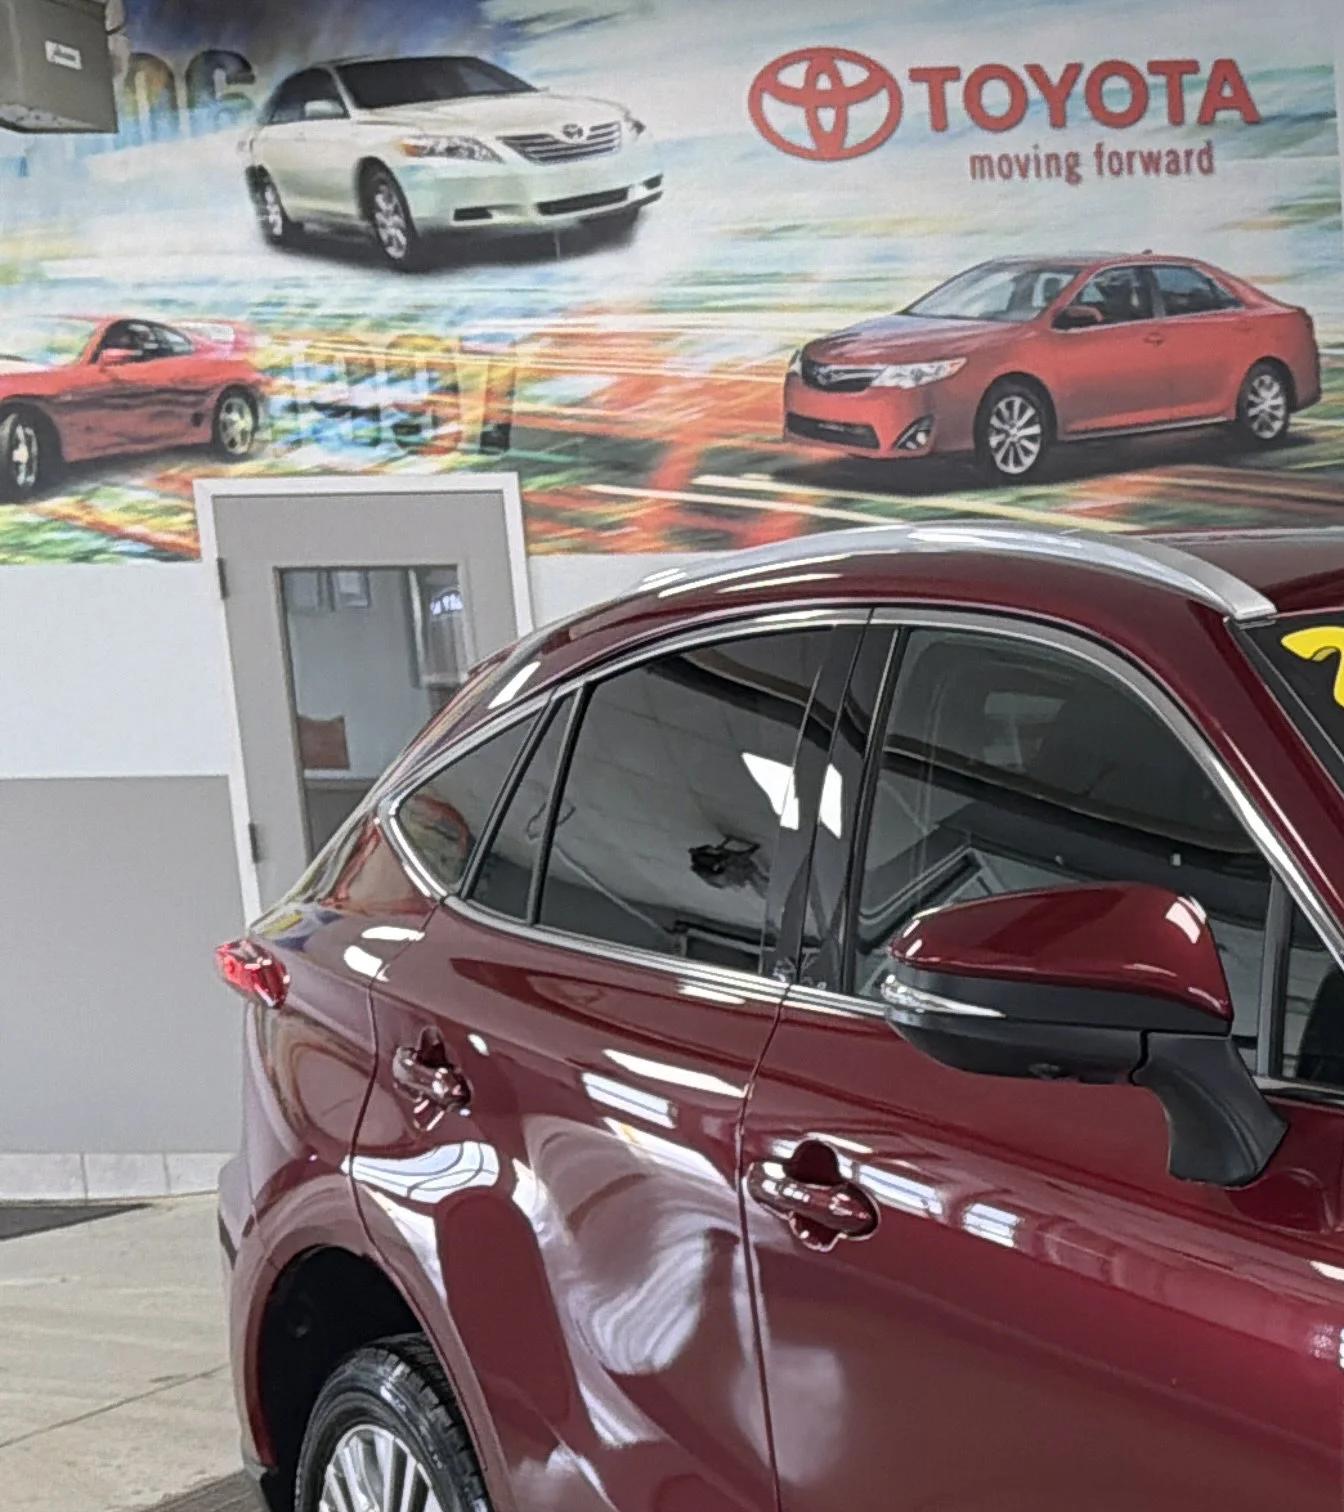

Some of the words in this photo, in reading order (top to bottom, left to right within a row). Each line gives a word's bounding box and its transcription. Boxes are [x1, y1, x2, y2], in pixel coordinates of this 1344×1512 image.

[908, 59, 1263, 134] TOYOTA
[968, 144, 1083, 186] moving
[1094, 138, 1216, 178] forward
